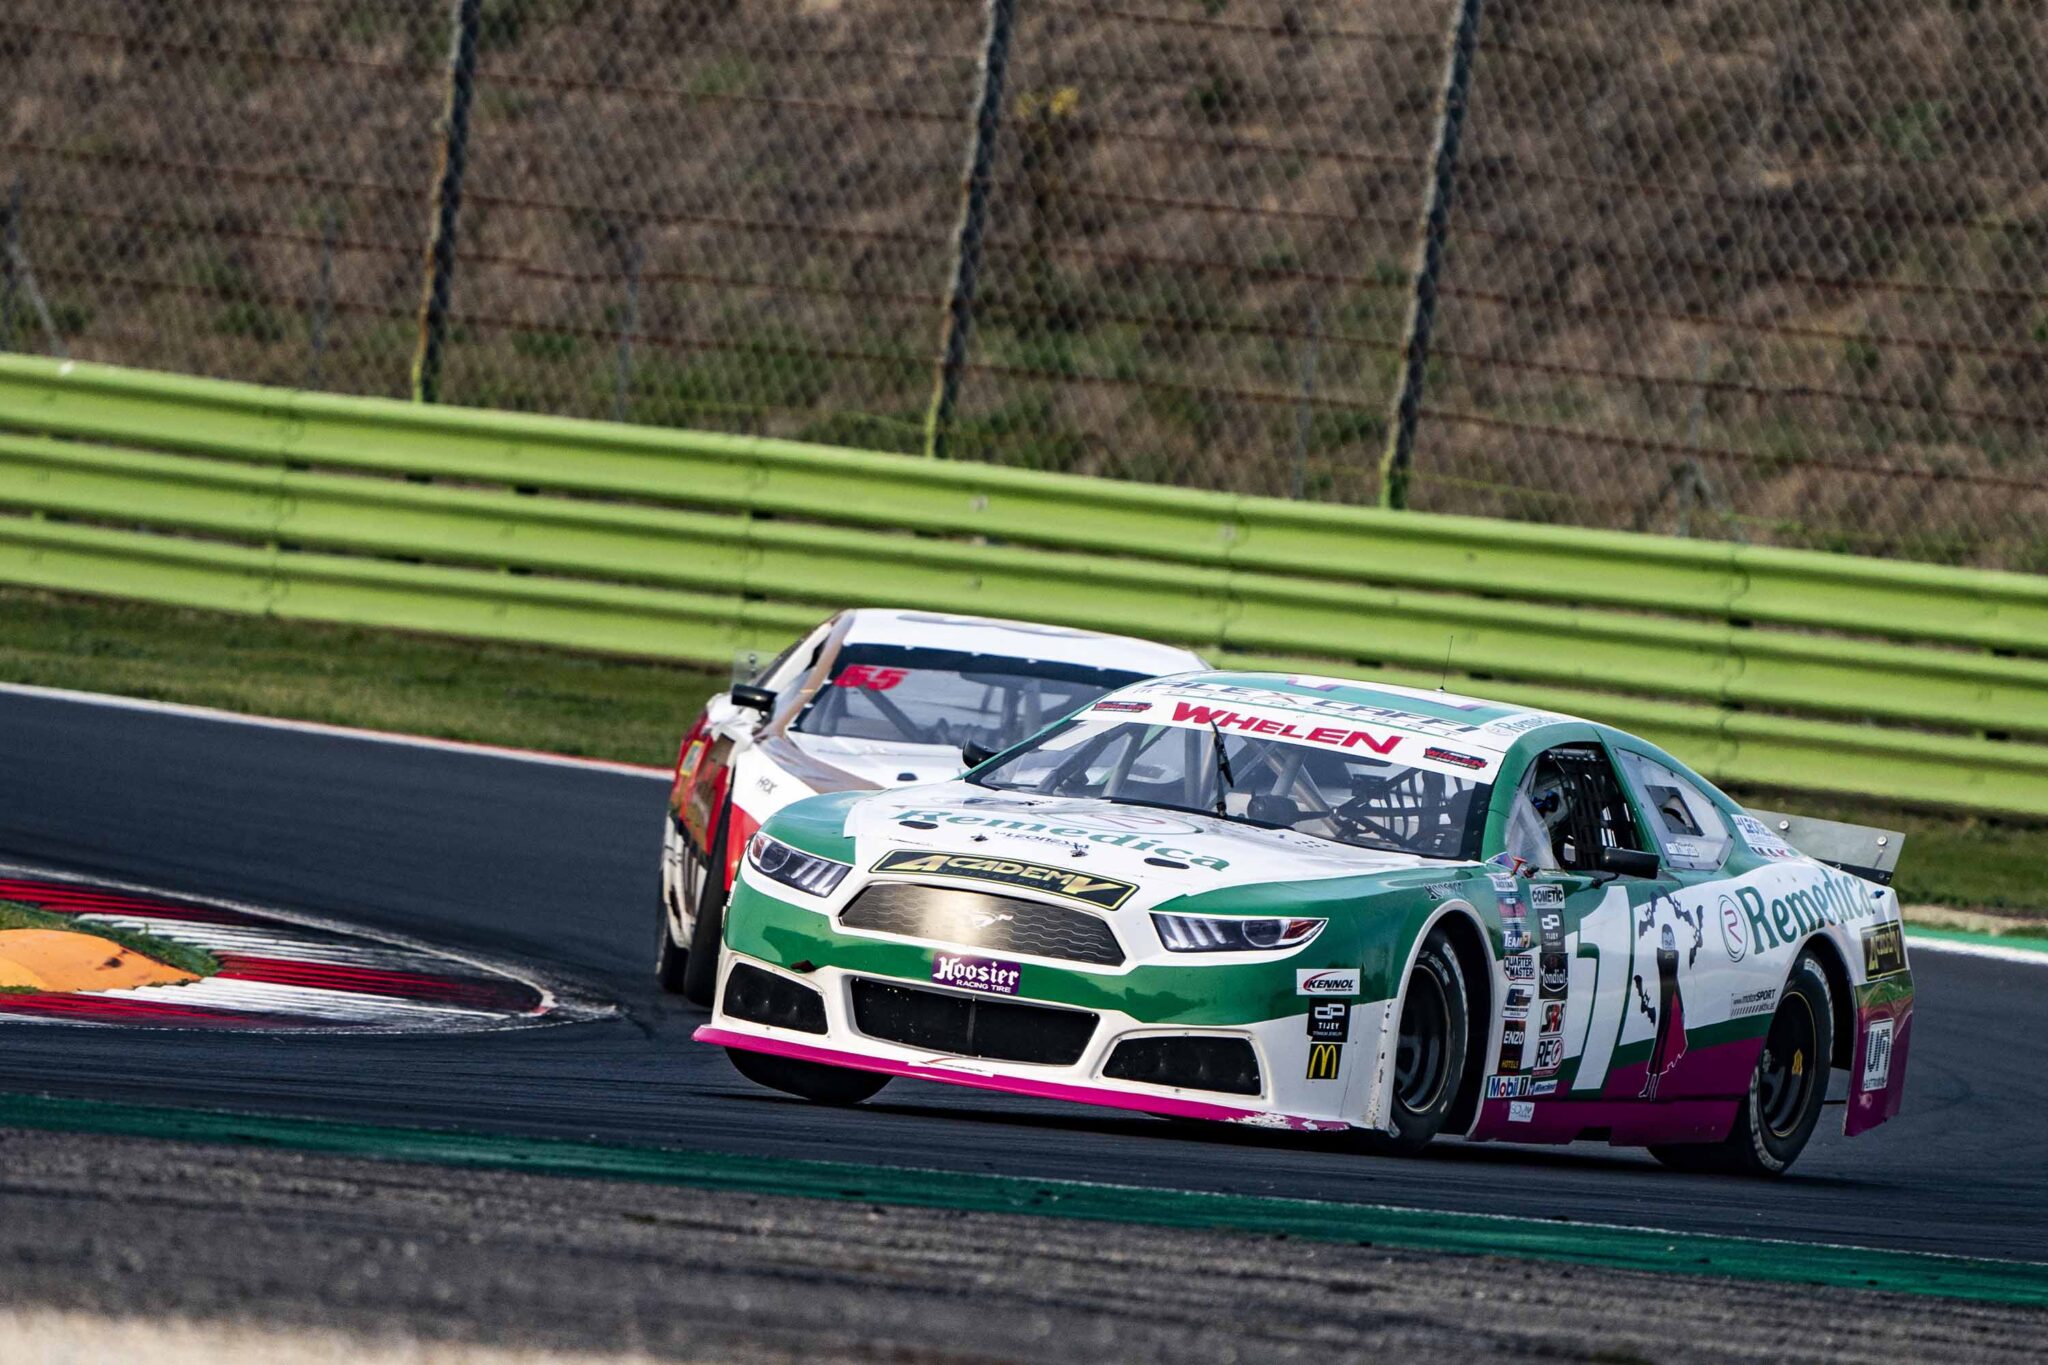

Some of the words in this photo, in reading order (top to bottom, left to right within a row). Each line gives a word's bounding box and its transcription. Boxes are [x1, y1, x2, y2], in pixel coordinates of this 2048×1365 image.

[1312, 700, 1480, 733] CAFFI
[1172, 702, 1403, 755] WHELEN
[889, 809, 1231, 872] Remedica
[883, 855, 1124, 894] ACADEMY
[1532, 889, 1563, 903] COMETIC
[1734, 868, 1876, 956] Remedica
[932, 956, 1020, 986] Hoosier
[1509, 966, 1534, 977] MASTER
[956, 979, 989, 990] RACING
[991, 984, 1012, 993] TIRE
[1308, 980, 1354, 989] KENNOL
[1318, 1022, 1340, 1030] TIJEY
[1503, 1031, 1525, 1045] ENZO
[1490, 1077, 1519, 1098] Mobil
